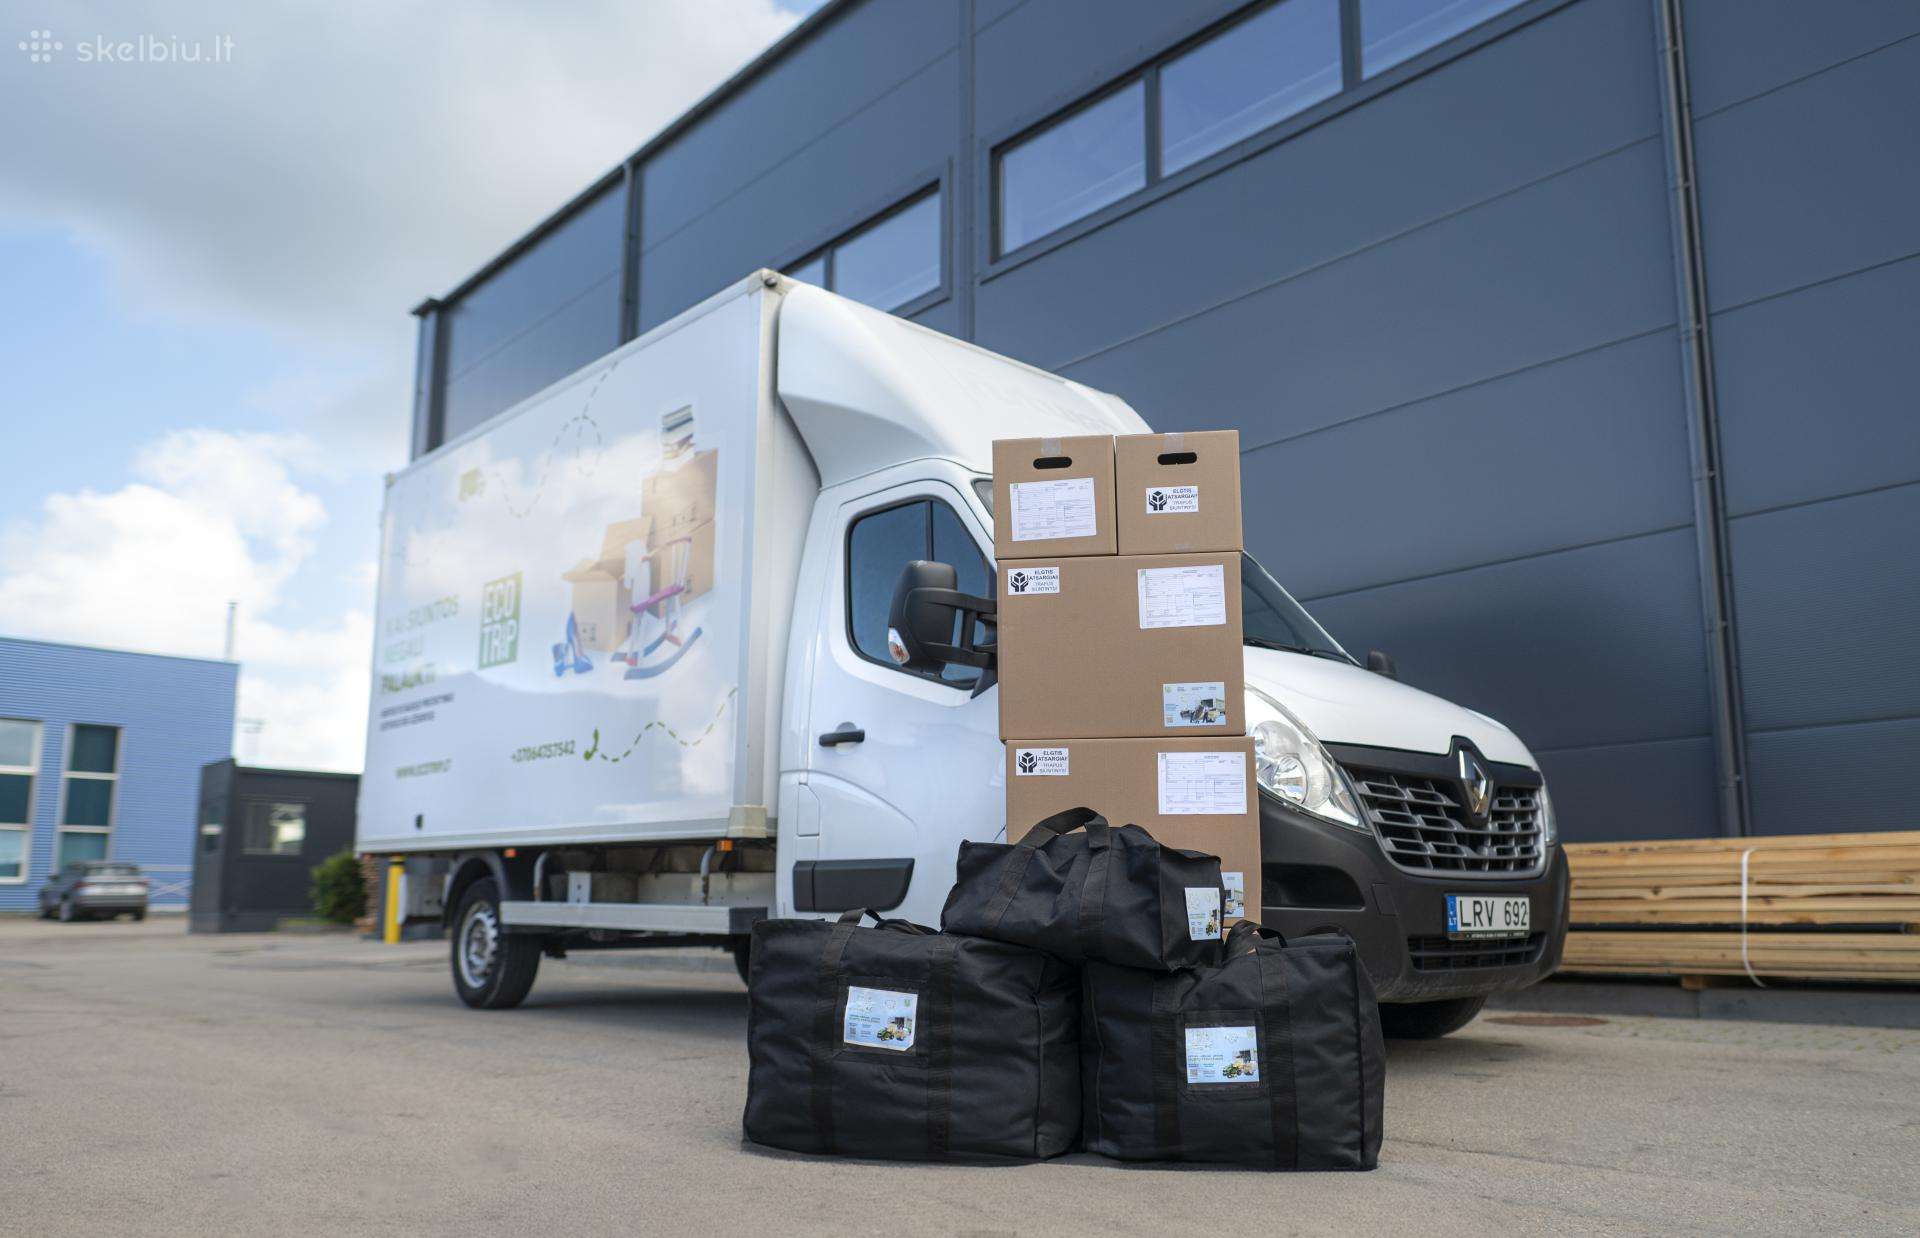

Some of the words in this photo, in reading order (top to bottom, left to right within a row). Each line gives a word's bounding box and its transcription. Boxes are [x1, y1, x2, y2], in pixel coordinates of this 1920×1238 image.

[481, 581, 516, 623] ECO
[480, 619, 518, 666] TRIP
[1448, 917, 1457, 926] LT
[1459, 900, 1495, 927] LRV
[1504, 900, 1528, 927] 692
